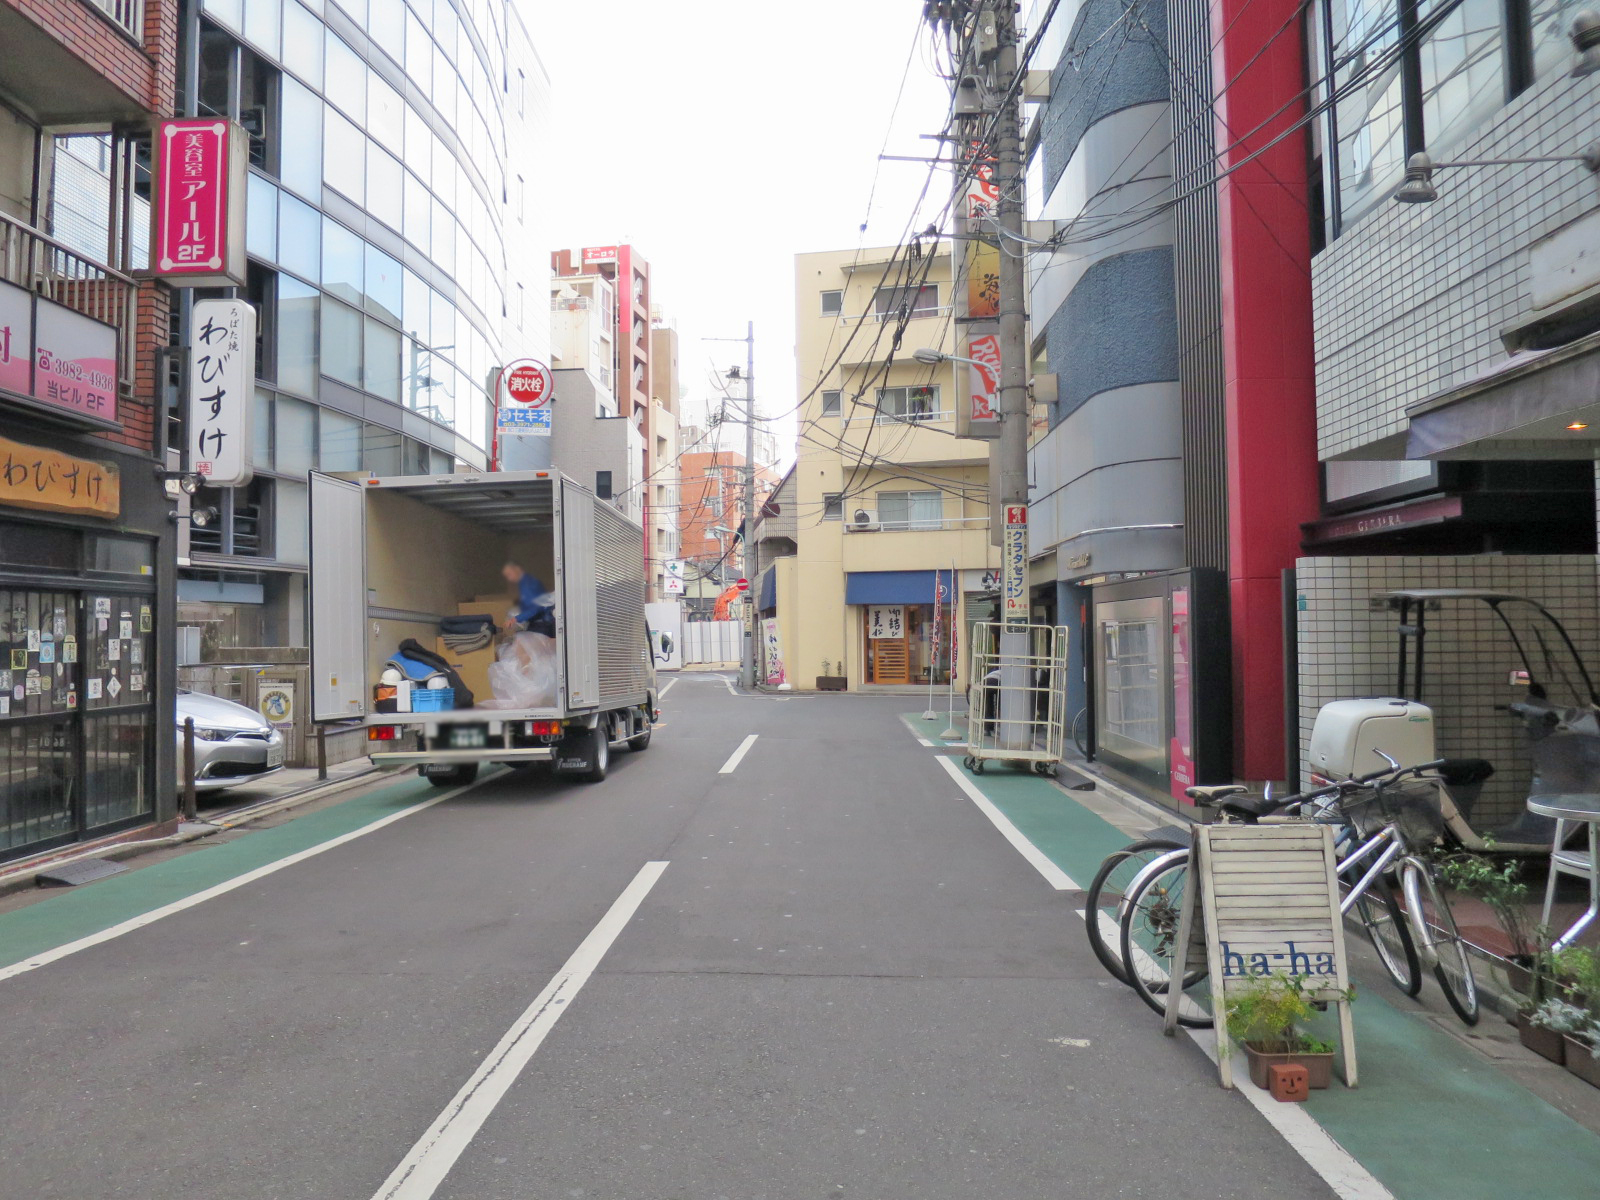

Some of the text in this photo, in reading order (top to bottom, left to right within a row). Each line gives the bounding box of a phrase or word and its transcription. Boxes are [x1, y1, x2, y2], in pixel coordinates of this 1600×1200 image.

[178, 133, 207, 243] 美容室 アール
[178, 244, 206, 261] 2F
[228, 307, 240, 352] ろばた焼
[55, 358, 114, 392] 3982-4936
[197, 316, 229, 460] わびすけ
[511, 377, 543, 392] 消火栓
[47, 380, 106, 411] 当ビル 2F
[3, 452, 102, 504] わびすけ
[1013, 530, 1024, 598] クラタセブン
[1219, 941, 1337, 976] ha-ha
